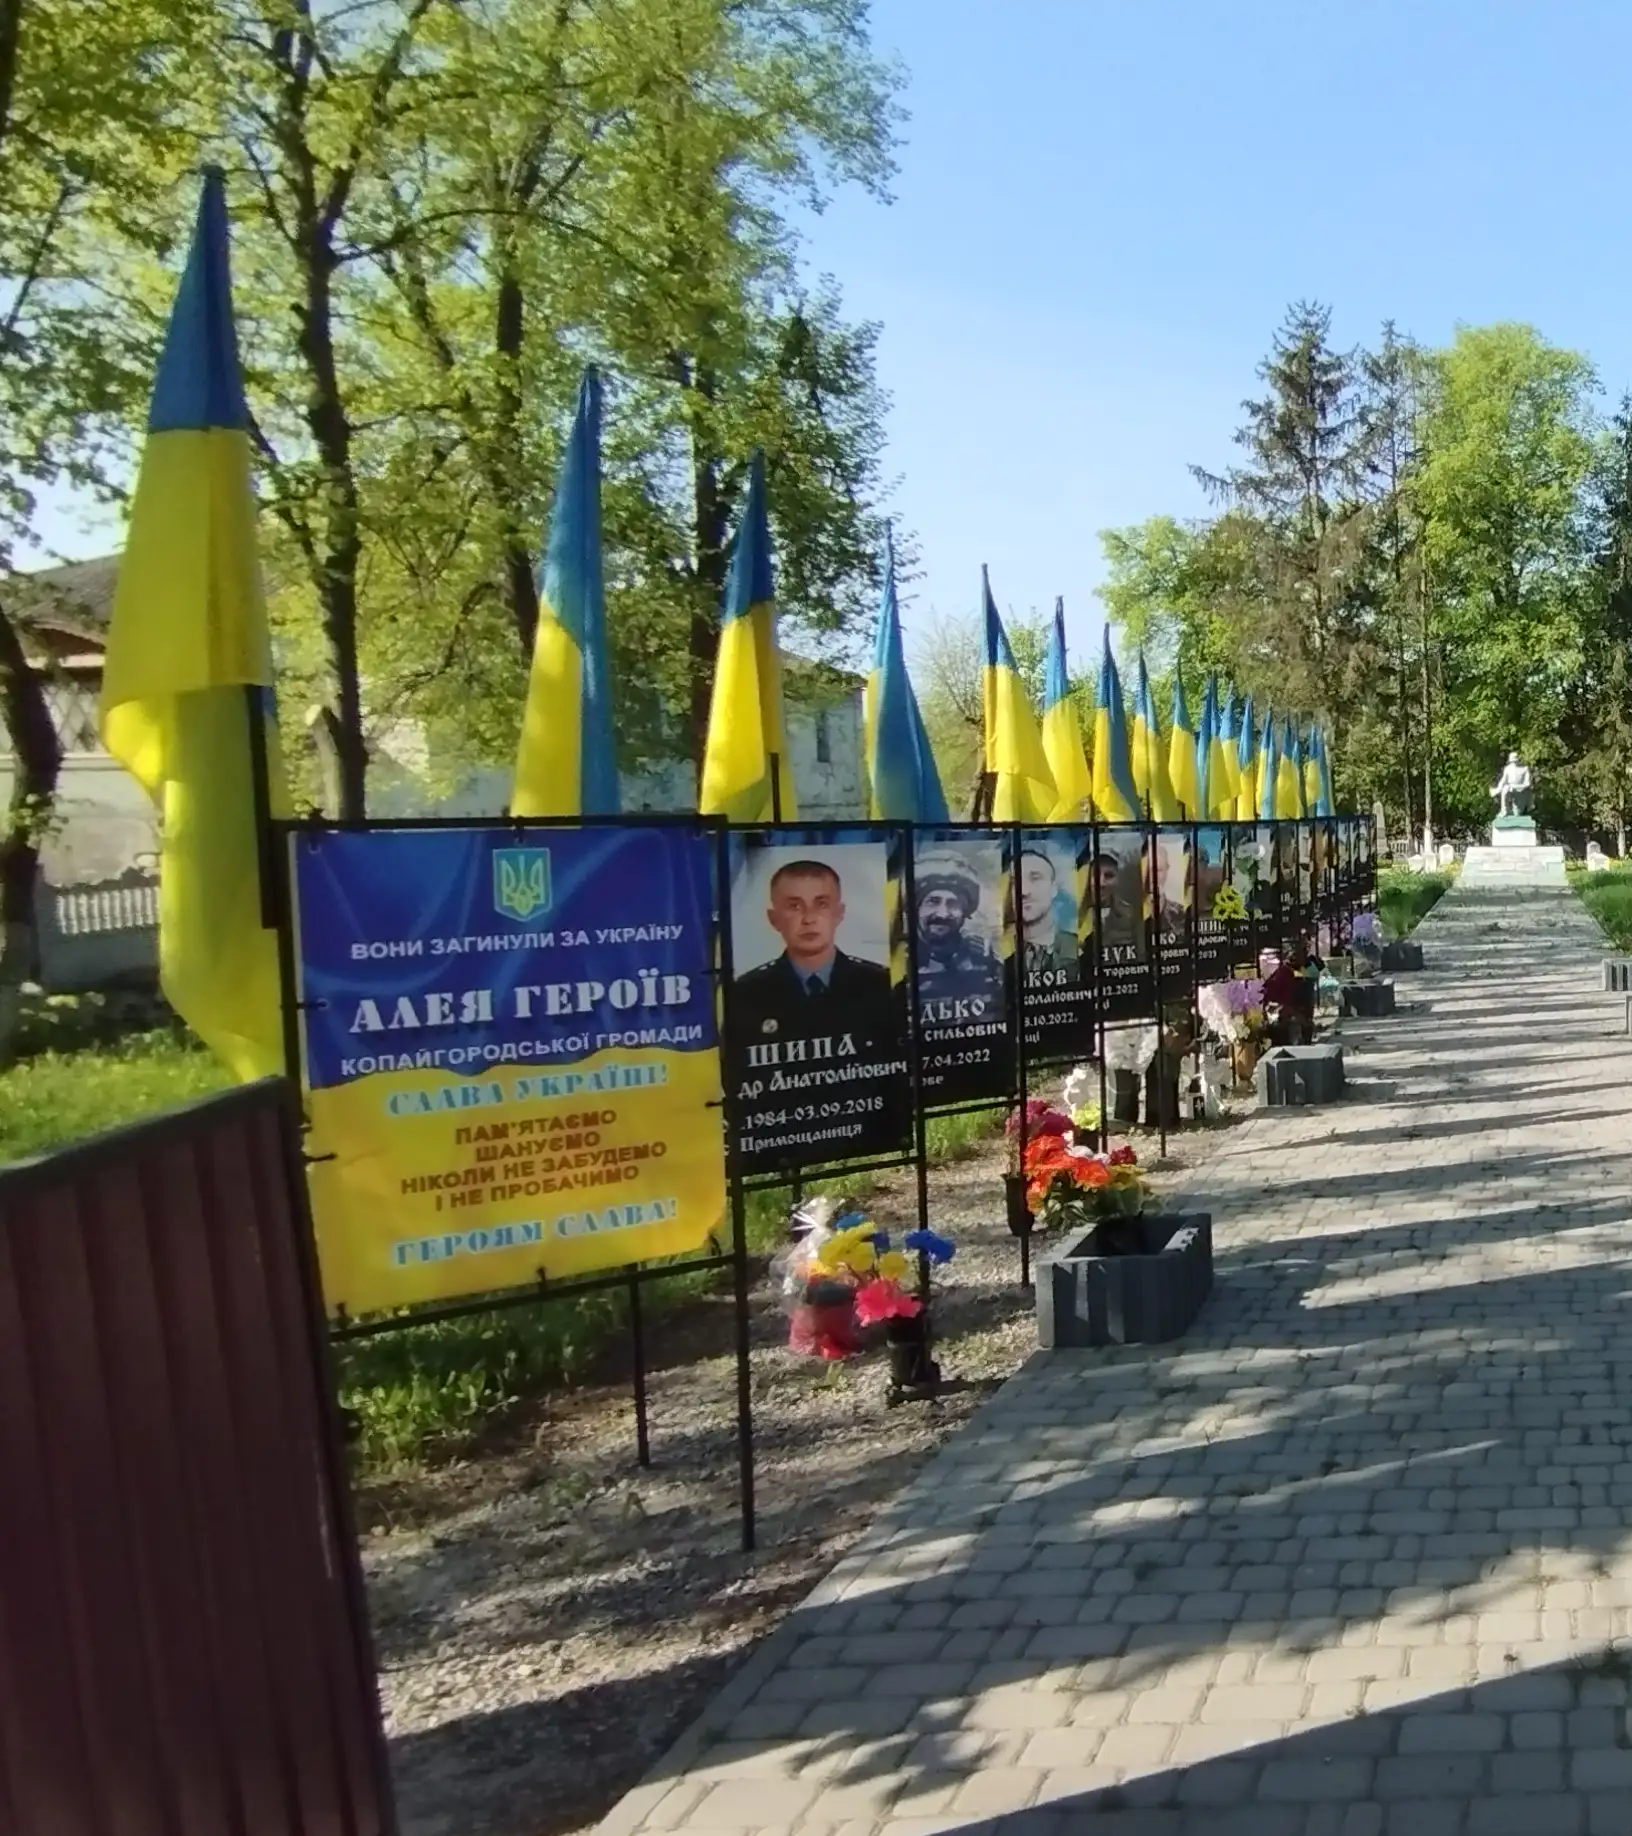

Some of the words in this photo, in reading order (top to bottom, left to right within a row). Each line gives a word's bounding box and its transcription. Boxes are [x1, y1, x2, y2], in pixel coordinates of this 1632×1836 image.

[351, 940, 423, 960] ВОНИ
[430, 933, 555, 955] ЗАГИНУЛИ
[560, 930, 590, 947] ЗА
[595, 923, 684, 945] УКРАЇНУ
[349, 988, 495, 1034] АЛЕЯ
[513, 967, 693, 1020] ГЕРОЇВ
[341, 1034, 591, 1077] КОПАЙГОРОДСЬКОЇ
[595, 1024, 703, 1049] ГРОМАДИ
[388, 1082, 505, 1116] СЛАВА
[516, 1063, 668, 1099] УКРАЇНІ!
[769, 1060, 908, 1092] Анатолійович
[476, 1130, 601, 1163] ШАНУЄМО
[739, 1123, 863, 1154] Примощаниця
[400, 1164, 497, 1196] НІКОЛИ
[503, 1159, 535, 1181] НЕ
[541, 1140, 668, 1174] ЗАБУДЕМО
[435, 1194, 443, 1212] І
[450, 1188, 484, 1210] НЕ
[490, 1164, 641, 1203] ПРОБАЧИМО
[396, 1220, 544, 1266] ГЕРОЯМ
[556, 1197, 678, 1239] СЛАВА!
